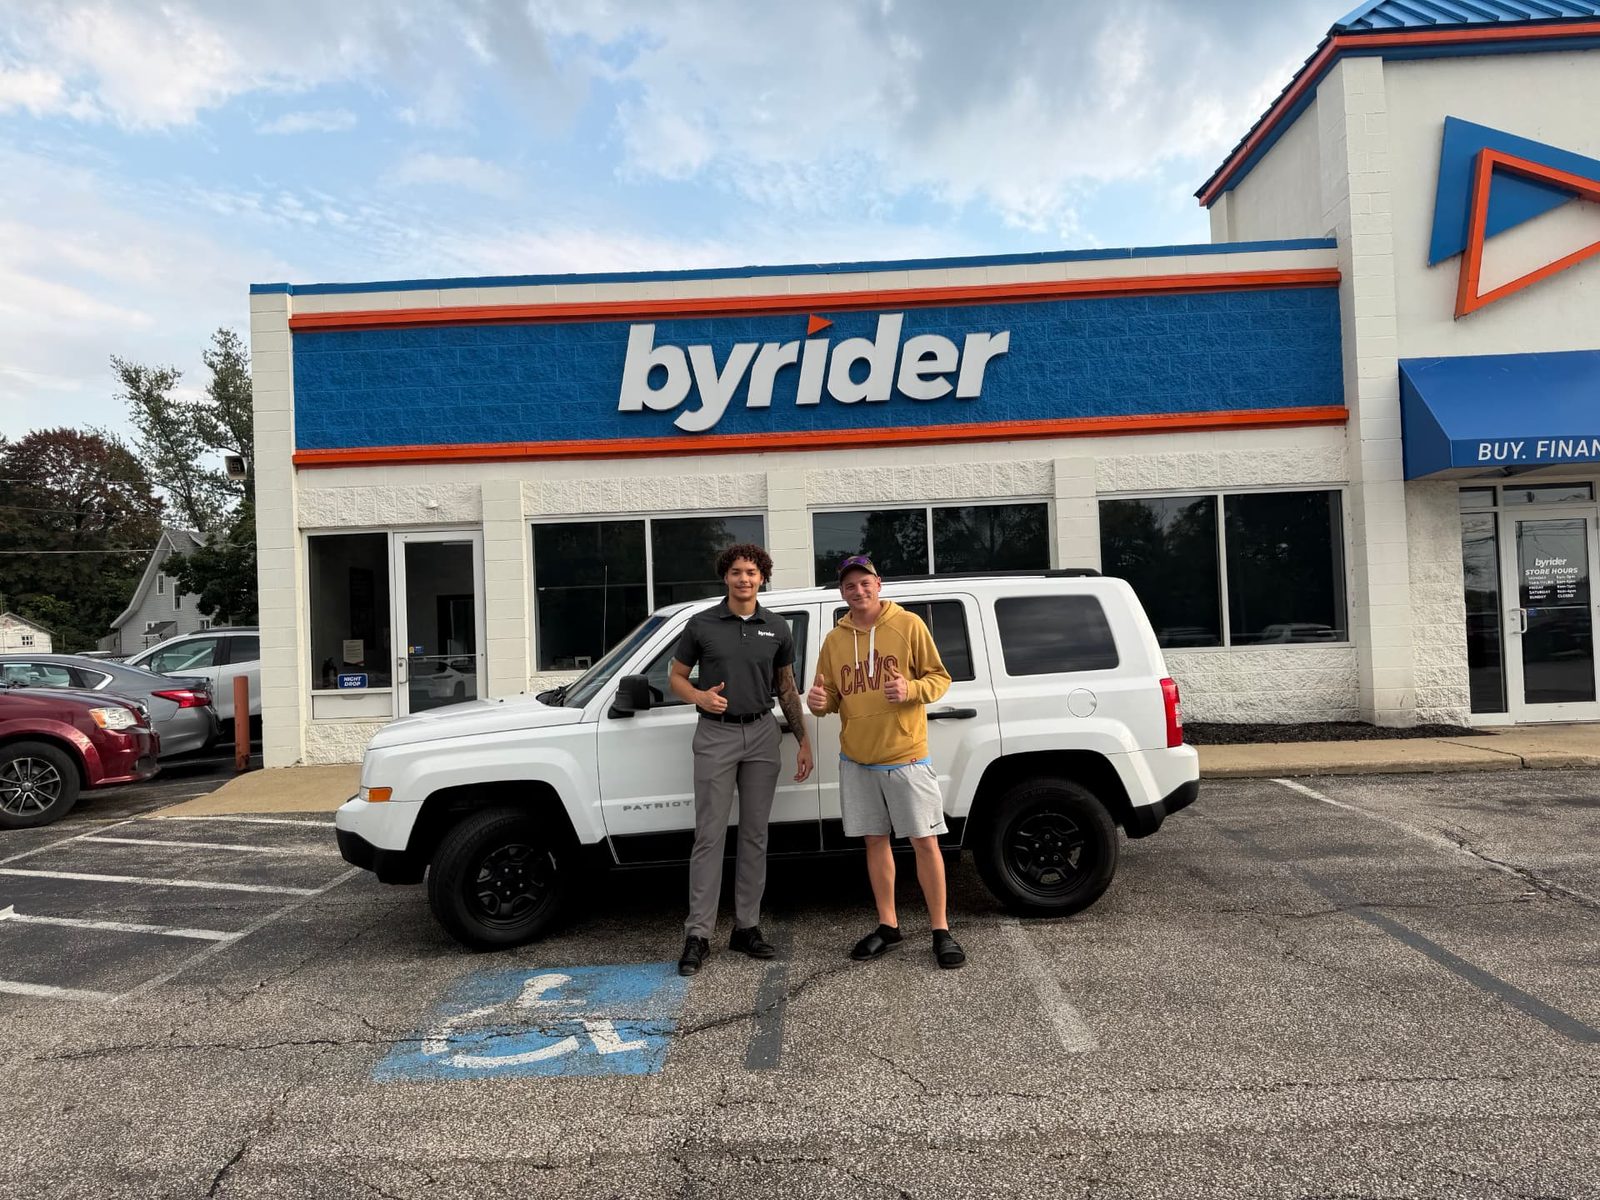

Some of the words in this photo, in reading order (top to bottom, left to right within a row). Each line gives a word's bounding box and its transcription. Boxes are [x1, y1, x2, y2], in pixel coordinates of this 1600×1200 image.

[618, 312, 1011, 432] byrider
[1478, 442, 1526, 461] BUY.
[1535, 557, 1567, 567] byrider
[623, 800, 692, 811] PATRIOT
